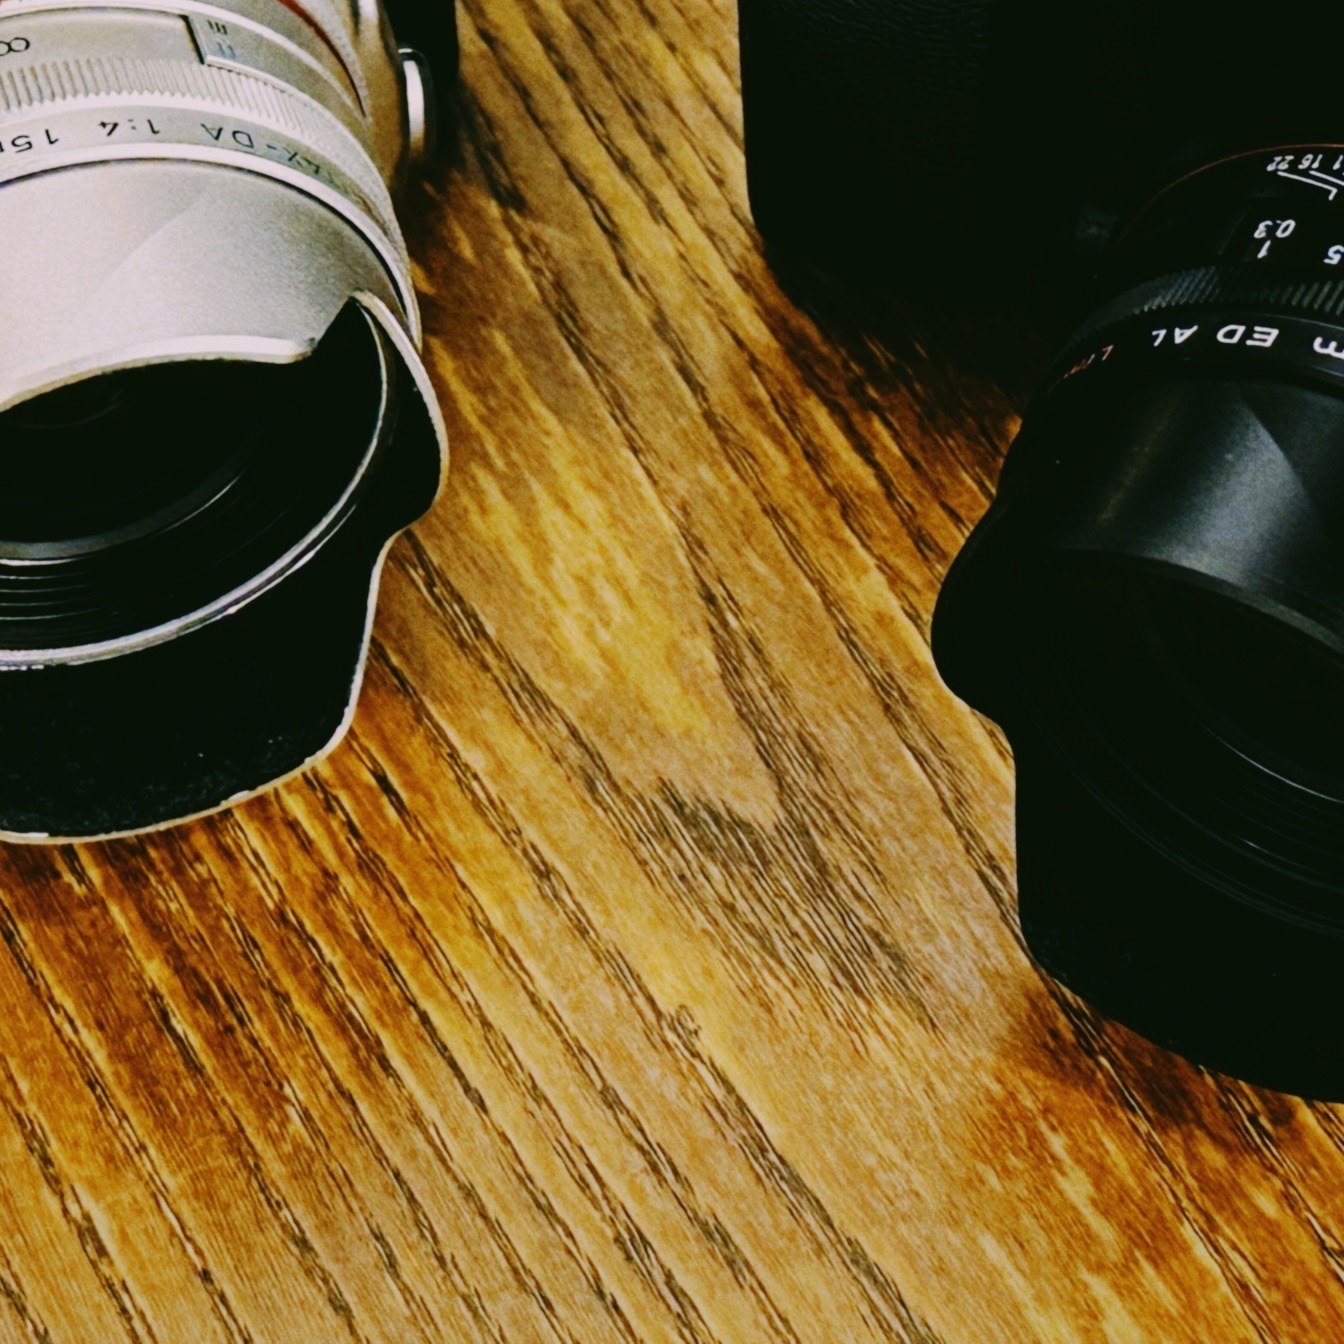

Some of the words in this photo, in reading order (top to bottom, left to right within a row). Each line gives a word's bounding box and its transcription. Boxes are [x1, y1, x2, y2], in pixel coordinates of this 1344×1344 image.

[1253, 219, 1296, 238] 0.3
[1151, 324, 1198, 347] AL
[1216, 323, 1280, 348] ED
